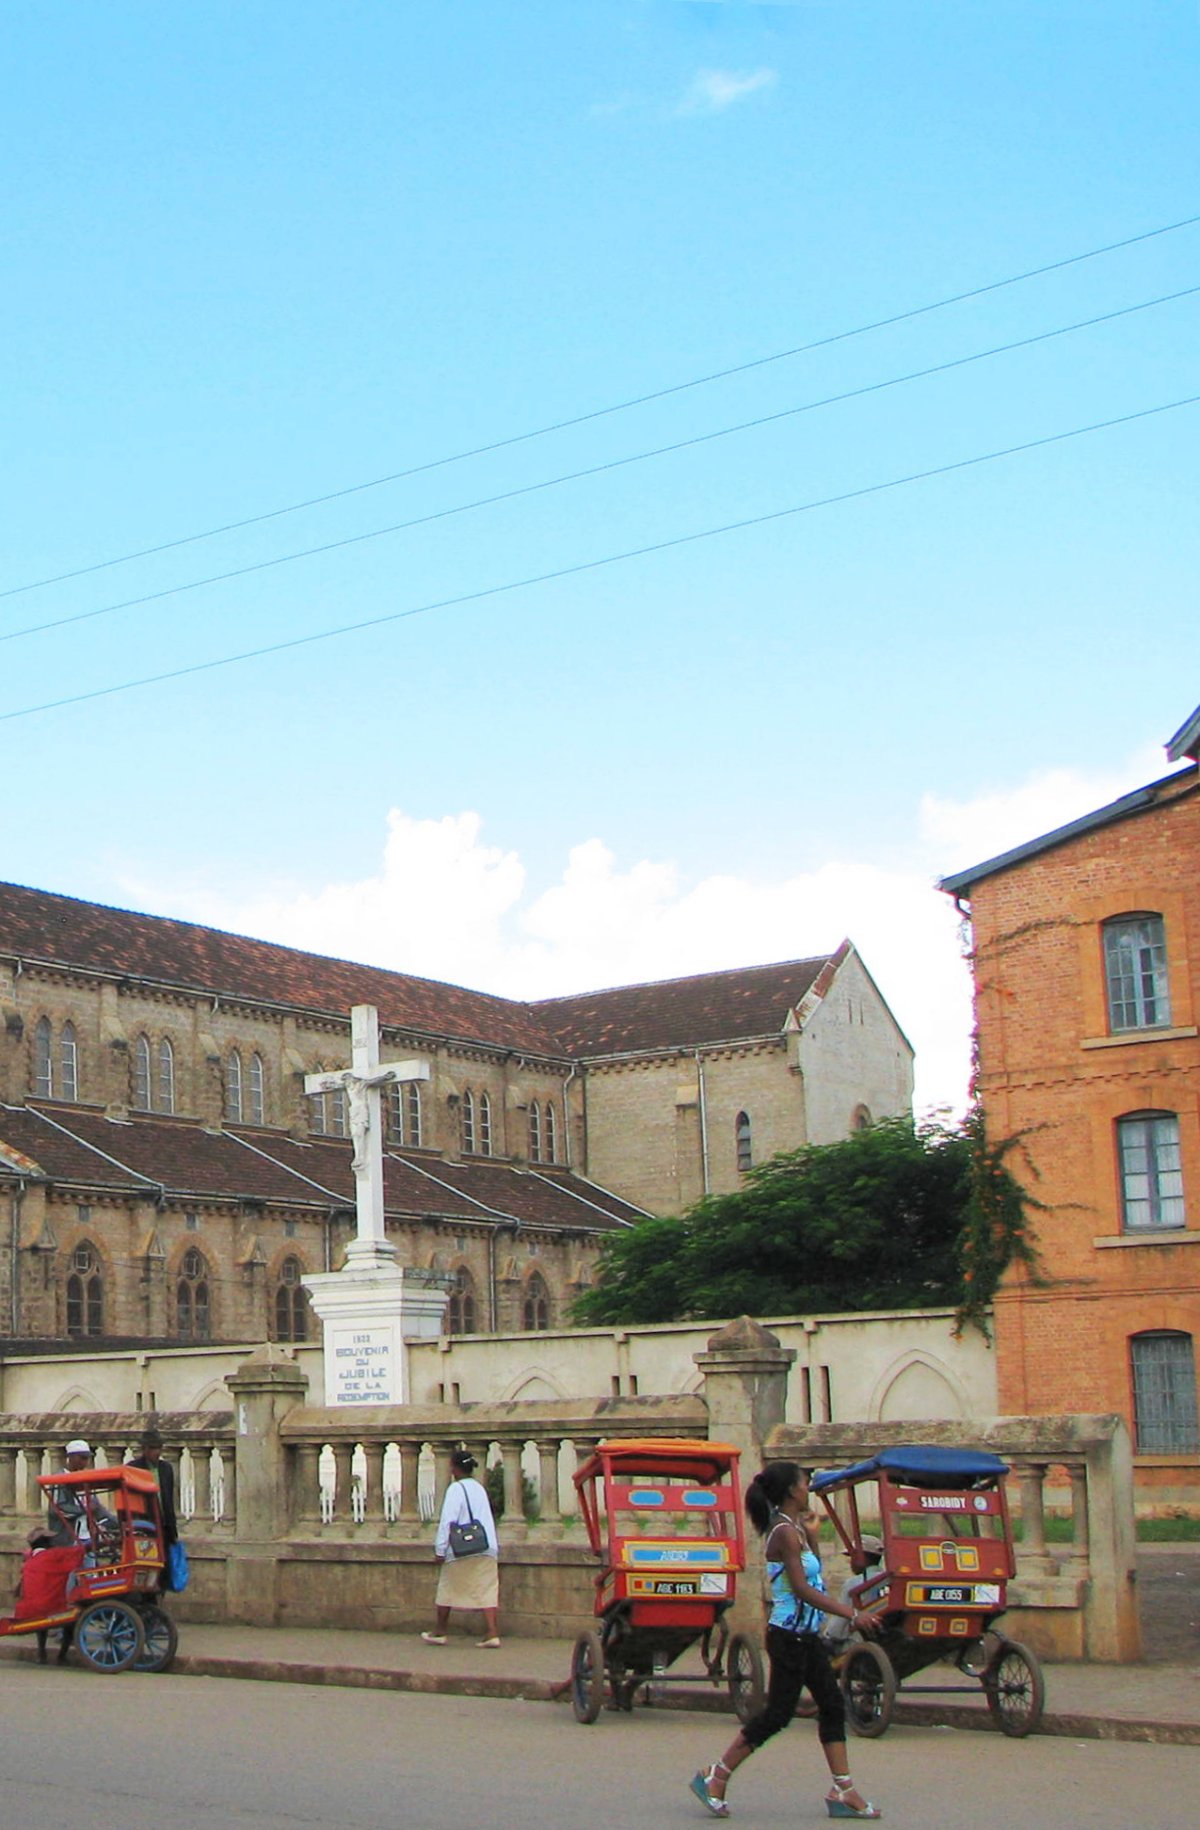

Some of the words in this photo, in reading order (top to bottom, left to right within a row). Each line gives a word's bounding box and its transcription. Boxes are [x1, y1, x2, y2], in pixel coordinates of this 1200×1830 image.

[335, 1345, 389, 1357] SOUVENIR
[356, 1358, 369, 1366] DU
[338, 1367, 387, 1379] JUBILE
[344, 1382, 360, 1390] DE
[365, 1381, 382, 1389] LA
[337, 1391, 390, 1402] REDEMPTION
[920, 1495, 966, 1509] SAROBIDY
